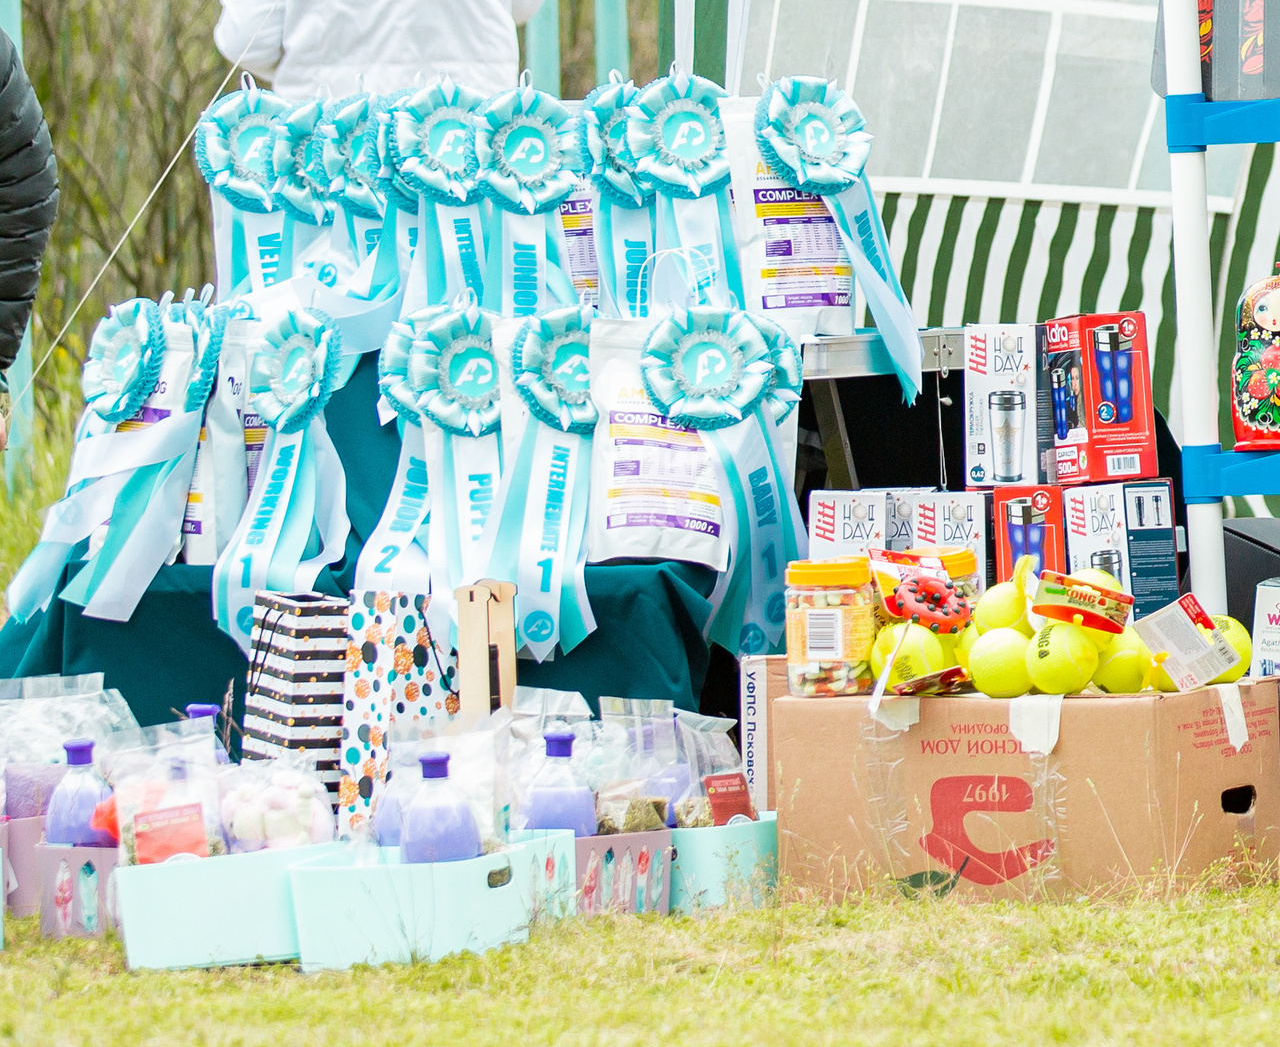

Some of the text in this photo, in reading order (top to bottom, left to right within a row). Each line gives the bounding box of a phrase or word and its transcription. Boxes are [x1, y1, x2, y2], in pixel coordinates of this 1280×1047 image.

[969, 333, 987, 375] Hitt
[994, 354, 1024, 373] DAY
[1058, 450, 1077, 459] CAPACITY
[244, 443, 296, 546] WORKING
[389, 455, 430, 533] JUNIOR
[747, 465, 778, 528] BABY
[685, 518, 707, 531] 1000
[815, 500, 836, 542] Hitt
[917, 502, 936, 544] Hitt
[1070, 494, 1087, 537] Hitt
[1091, 513, 1116, 533] DAY
[843, 523, 875, 541] DAY
[944, 523, 974, 542] DAY
[239, 556, 252, 588] 1
[374, 545, 401, 574] 2
[762, 541, 777, 579] 1
[537, 557, 553, 593] 1
[1065, 587, 1096, 604] KONG
[746, 672, 757, 716] УФПС
[951, 723, 1009, 735] ОРОДИНА
[921, 739, 961, 755] ДОМ
[963, 782, 1010, 803] 1997
